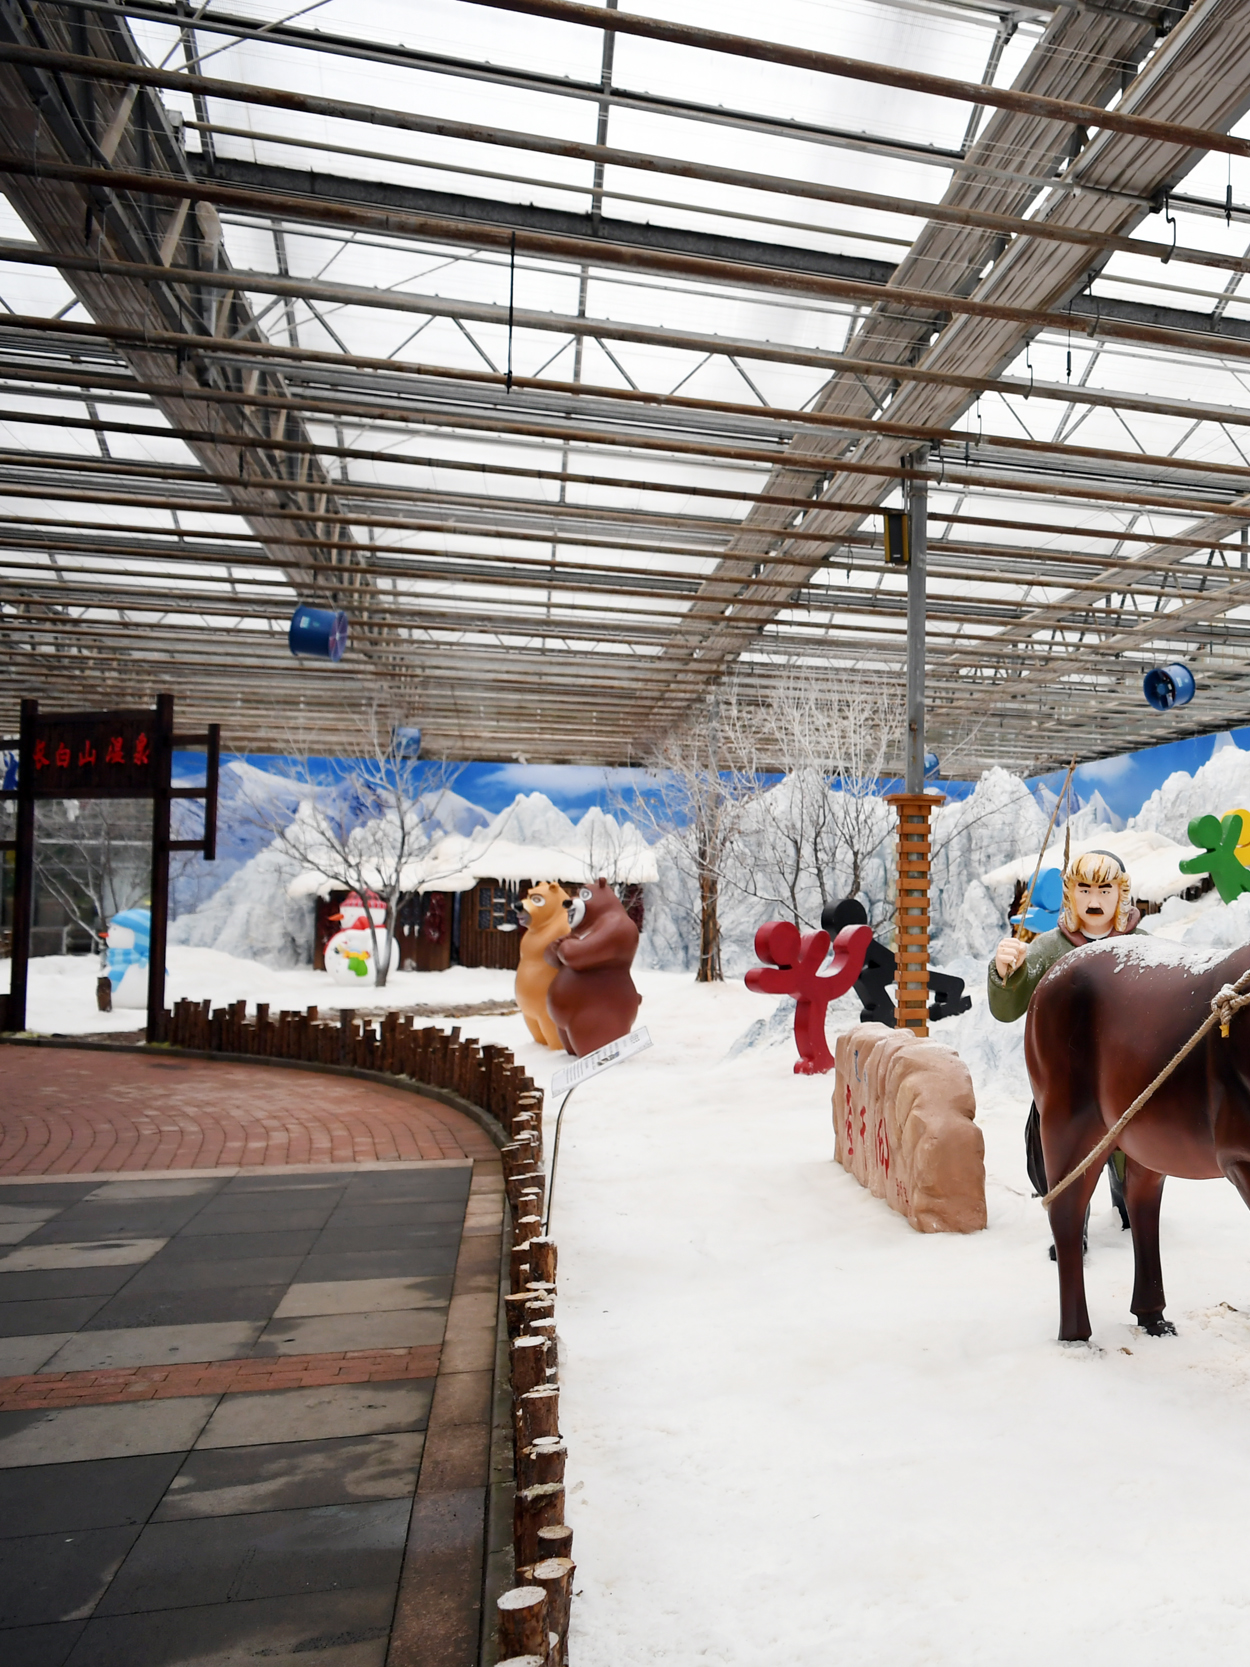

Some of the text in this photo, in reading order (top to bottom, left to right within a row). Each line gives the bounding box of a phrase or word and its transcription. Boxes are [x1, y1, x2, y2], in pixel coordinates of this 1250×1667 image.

[33, 732, 150, 770] 长白山温泉
